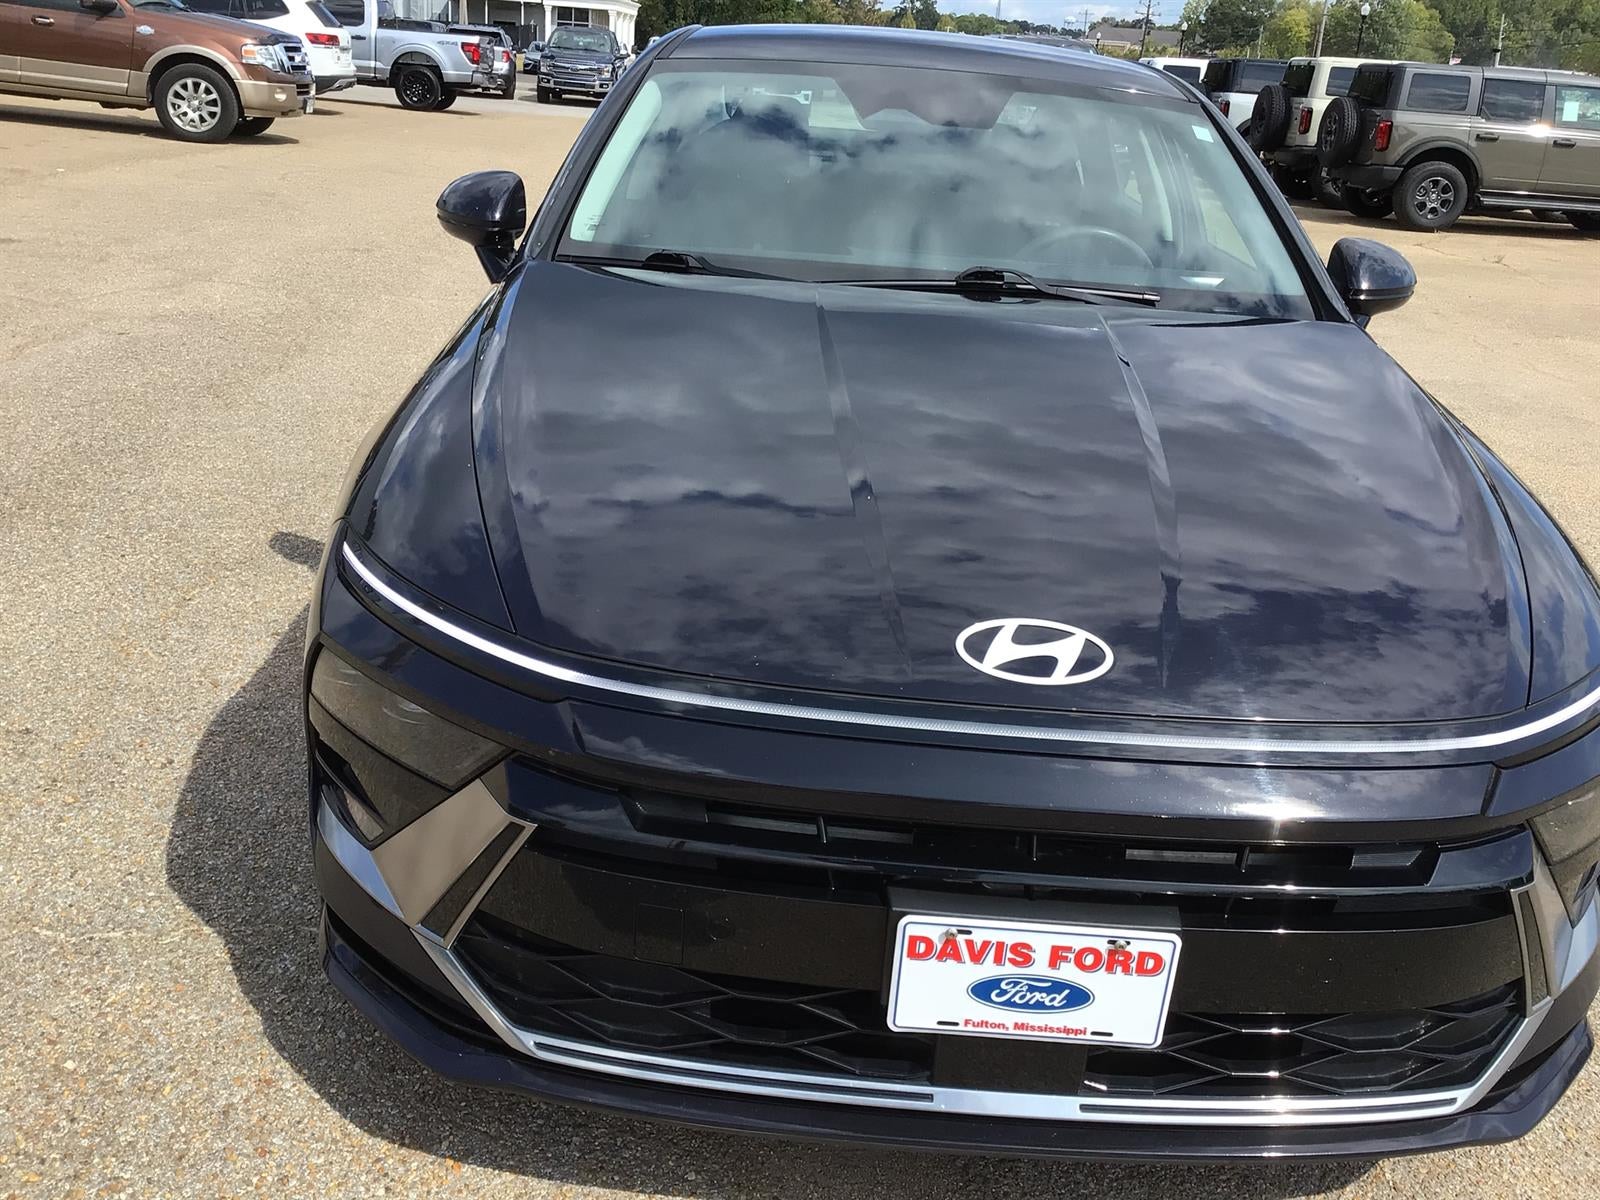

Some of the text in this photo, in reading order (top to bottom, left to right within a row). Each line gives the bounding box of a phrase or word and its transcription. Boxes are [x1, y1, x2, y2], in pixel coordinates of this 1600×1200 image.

[906, 934, 1166, 977] DAVIS FORD
[990, 978, 1071, 1007] Ford
[963, 1018, 1088, 1036] Fulton, Mississippi
